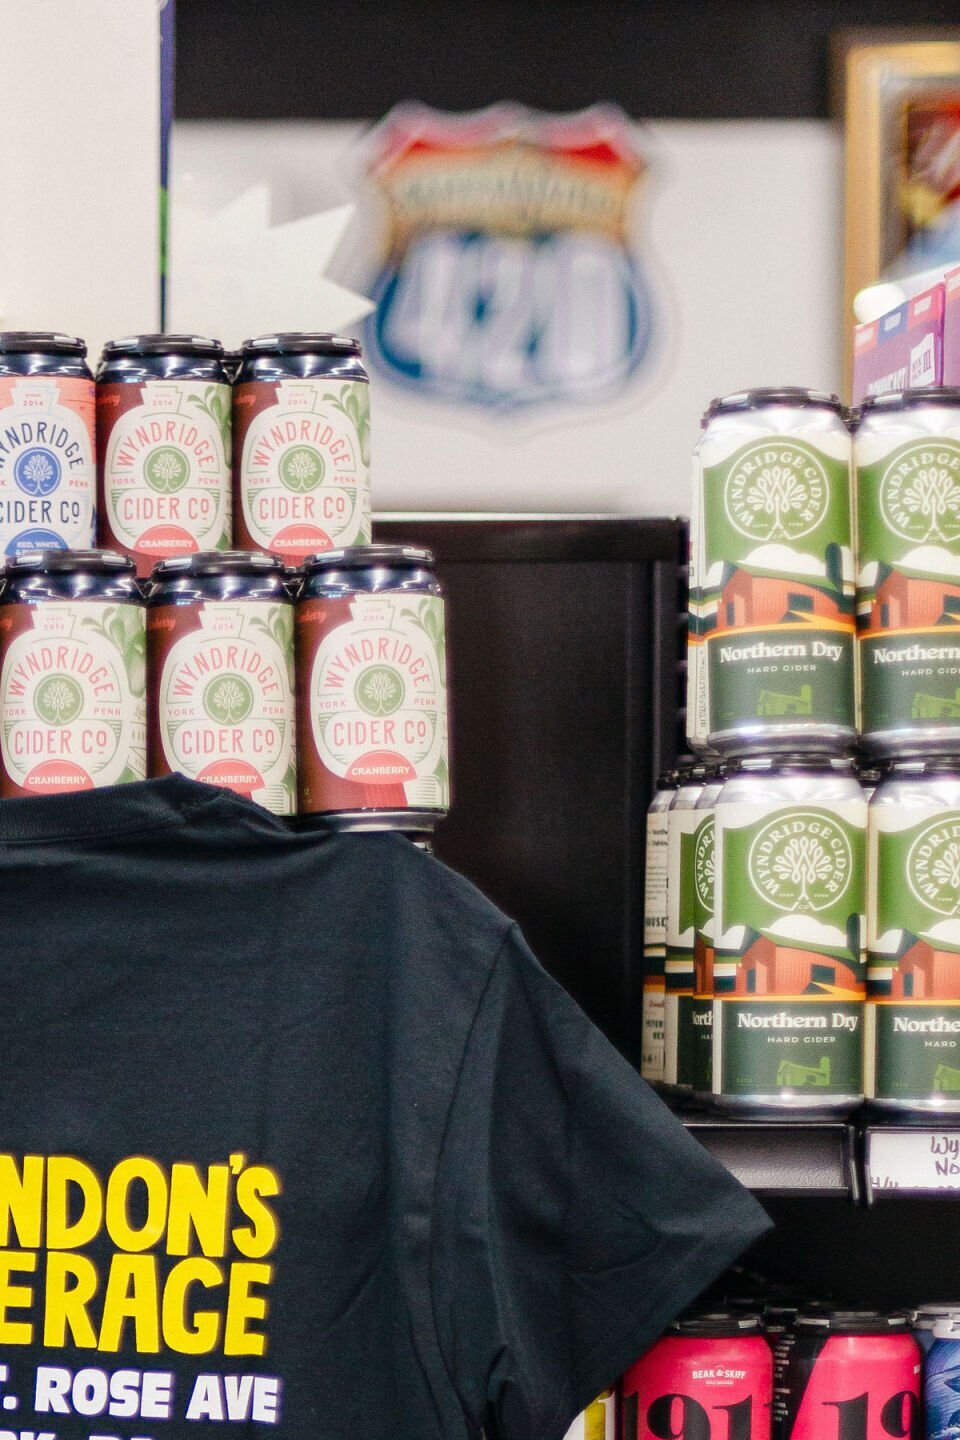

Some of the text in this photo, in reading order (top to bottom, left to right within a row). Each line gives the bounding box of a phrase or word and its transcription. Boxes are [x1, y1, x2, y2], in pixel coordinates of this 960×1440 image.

[116, 420, 214, 467] WYNDRIDGE
[251, 419, 351, 467] WYNDRIDGE
[730, 451, 823, 528] WYNDRIDGE CIDER
[123, 497, 180, 521] CIDER
[138, 539, 194, 549] CRANBERRY
[324, 637, 431, 690] WYNDRIDGE
[719, 640, 844, 664] Northern Dry
[8, 645, 115, 698] WYNDRIDGE
[172, 645, 279, 697] WYNDRIDGE
[746, 664, 817, 675] HARD CIDER
[333, 720, 396, 747] CIDER
[28, 775, 87, 785] CRANBERRY
[351, 766, 410, 777] CRANBERRY
[756, 820, 847, 896] WYNDRIDGE CIDER
[737, 1011, 859, 1033] Northern Dry
[767, 1035, 836, 1044] HARD CIDER
[692, 1370, 715, 1379] BEAK
[35, 1365, 171, 1419] ROSE
[186, 1374, 280, 1422] AVE
